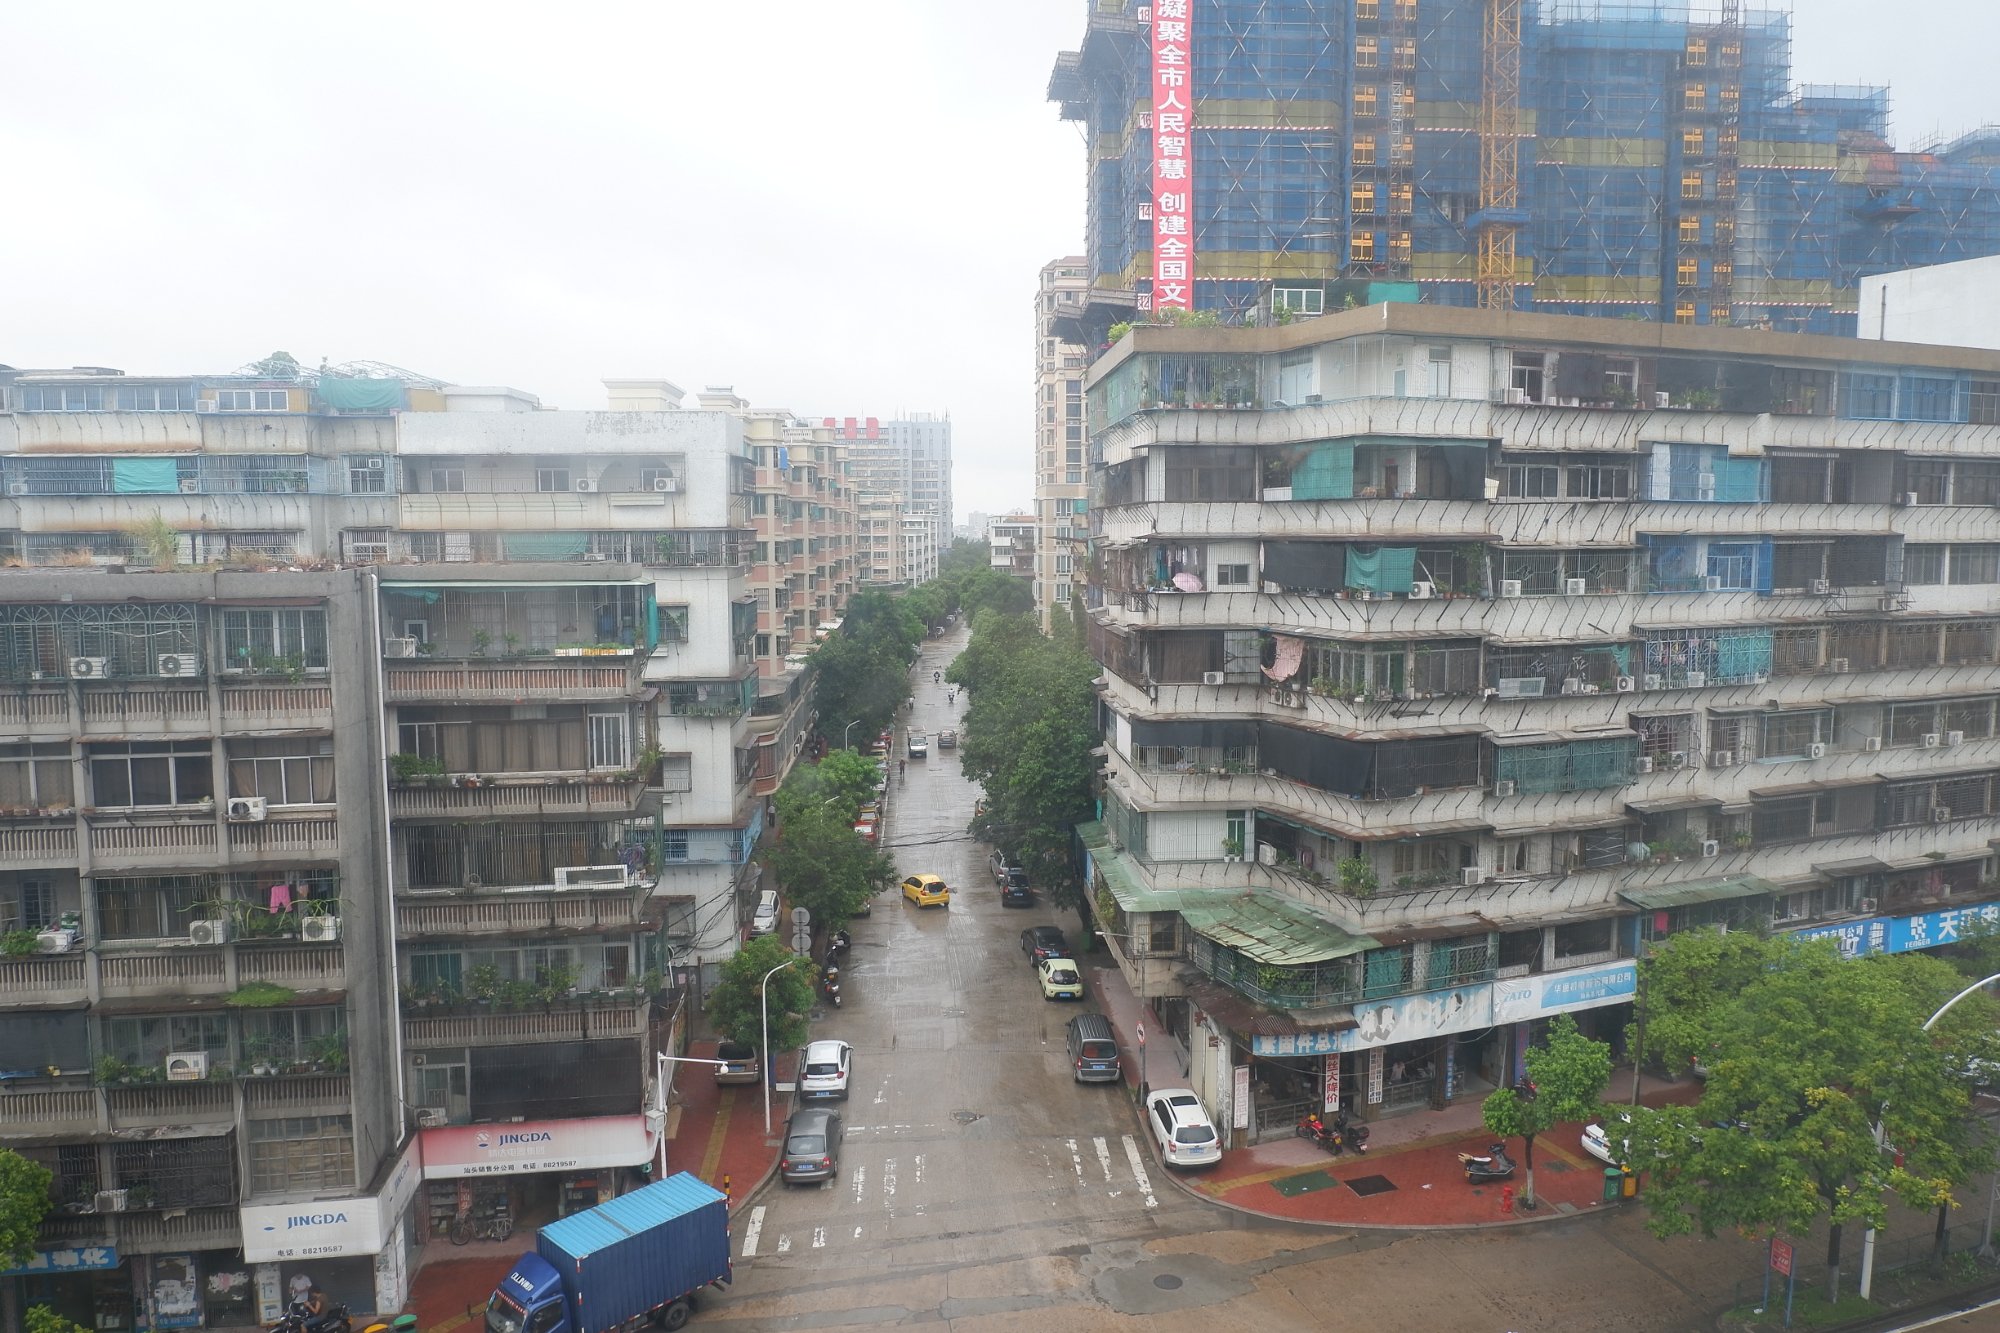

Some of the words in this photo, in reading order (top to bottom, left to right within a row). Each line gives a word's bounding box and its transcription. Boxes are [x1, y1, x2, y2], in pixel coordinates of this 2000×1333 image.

[1157, 0, 1187, 180] 凝聚全市人民智慧
[1140, 205, 1151, 219] 14
[499, 1131, 552, 1146] JINGDA
[463, 1164, 515, 1174] 汕头销售分公司
[543, 1160, 577, 1169] 88219587
[287, 1212, 348, 1229] JINGDA
[302, 1245, 343, 1255] 88219587
